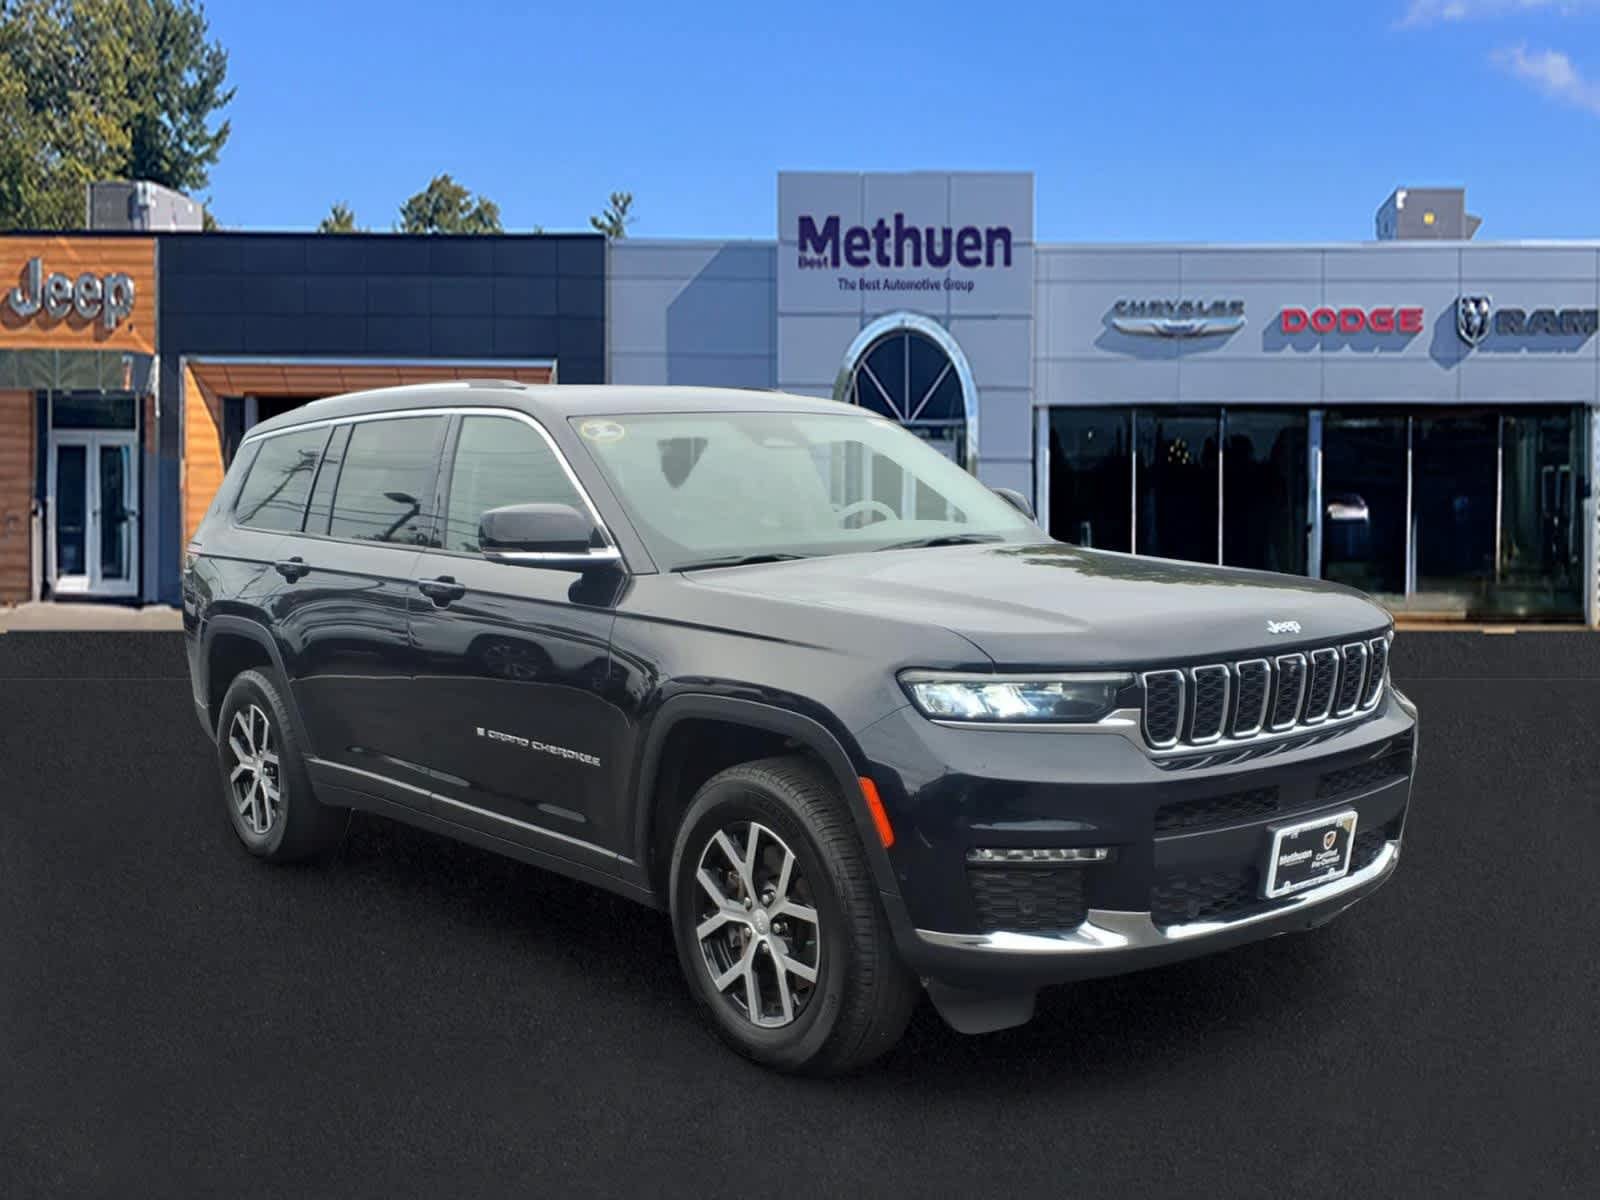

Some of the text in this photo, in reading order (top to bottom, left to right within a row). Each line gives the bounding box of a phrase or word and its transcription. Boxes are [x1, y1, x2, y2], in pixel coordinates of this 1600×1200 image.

[797, 213, 1012, 268] Methuen
[798, 256, 829, 269] Best
[9, 257, 135, 329] Jeep
[838, 278, 975, 293] The Best Automotive Group
[1114, 300, 1245, 317] CHRYSLER
[1281, 307, 1423, 334] DODGE
[1495, 308, 1599, 336] RAM
[1266, 620, 1302, 634] Jeep
[487, 729, 601, 767] GRAND CHEROKEE
